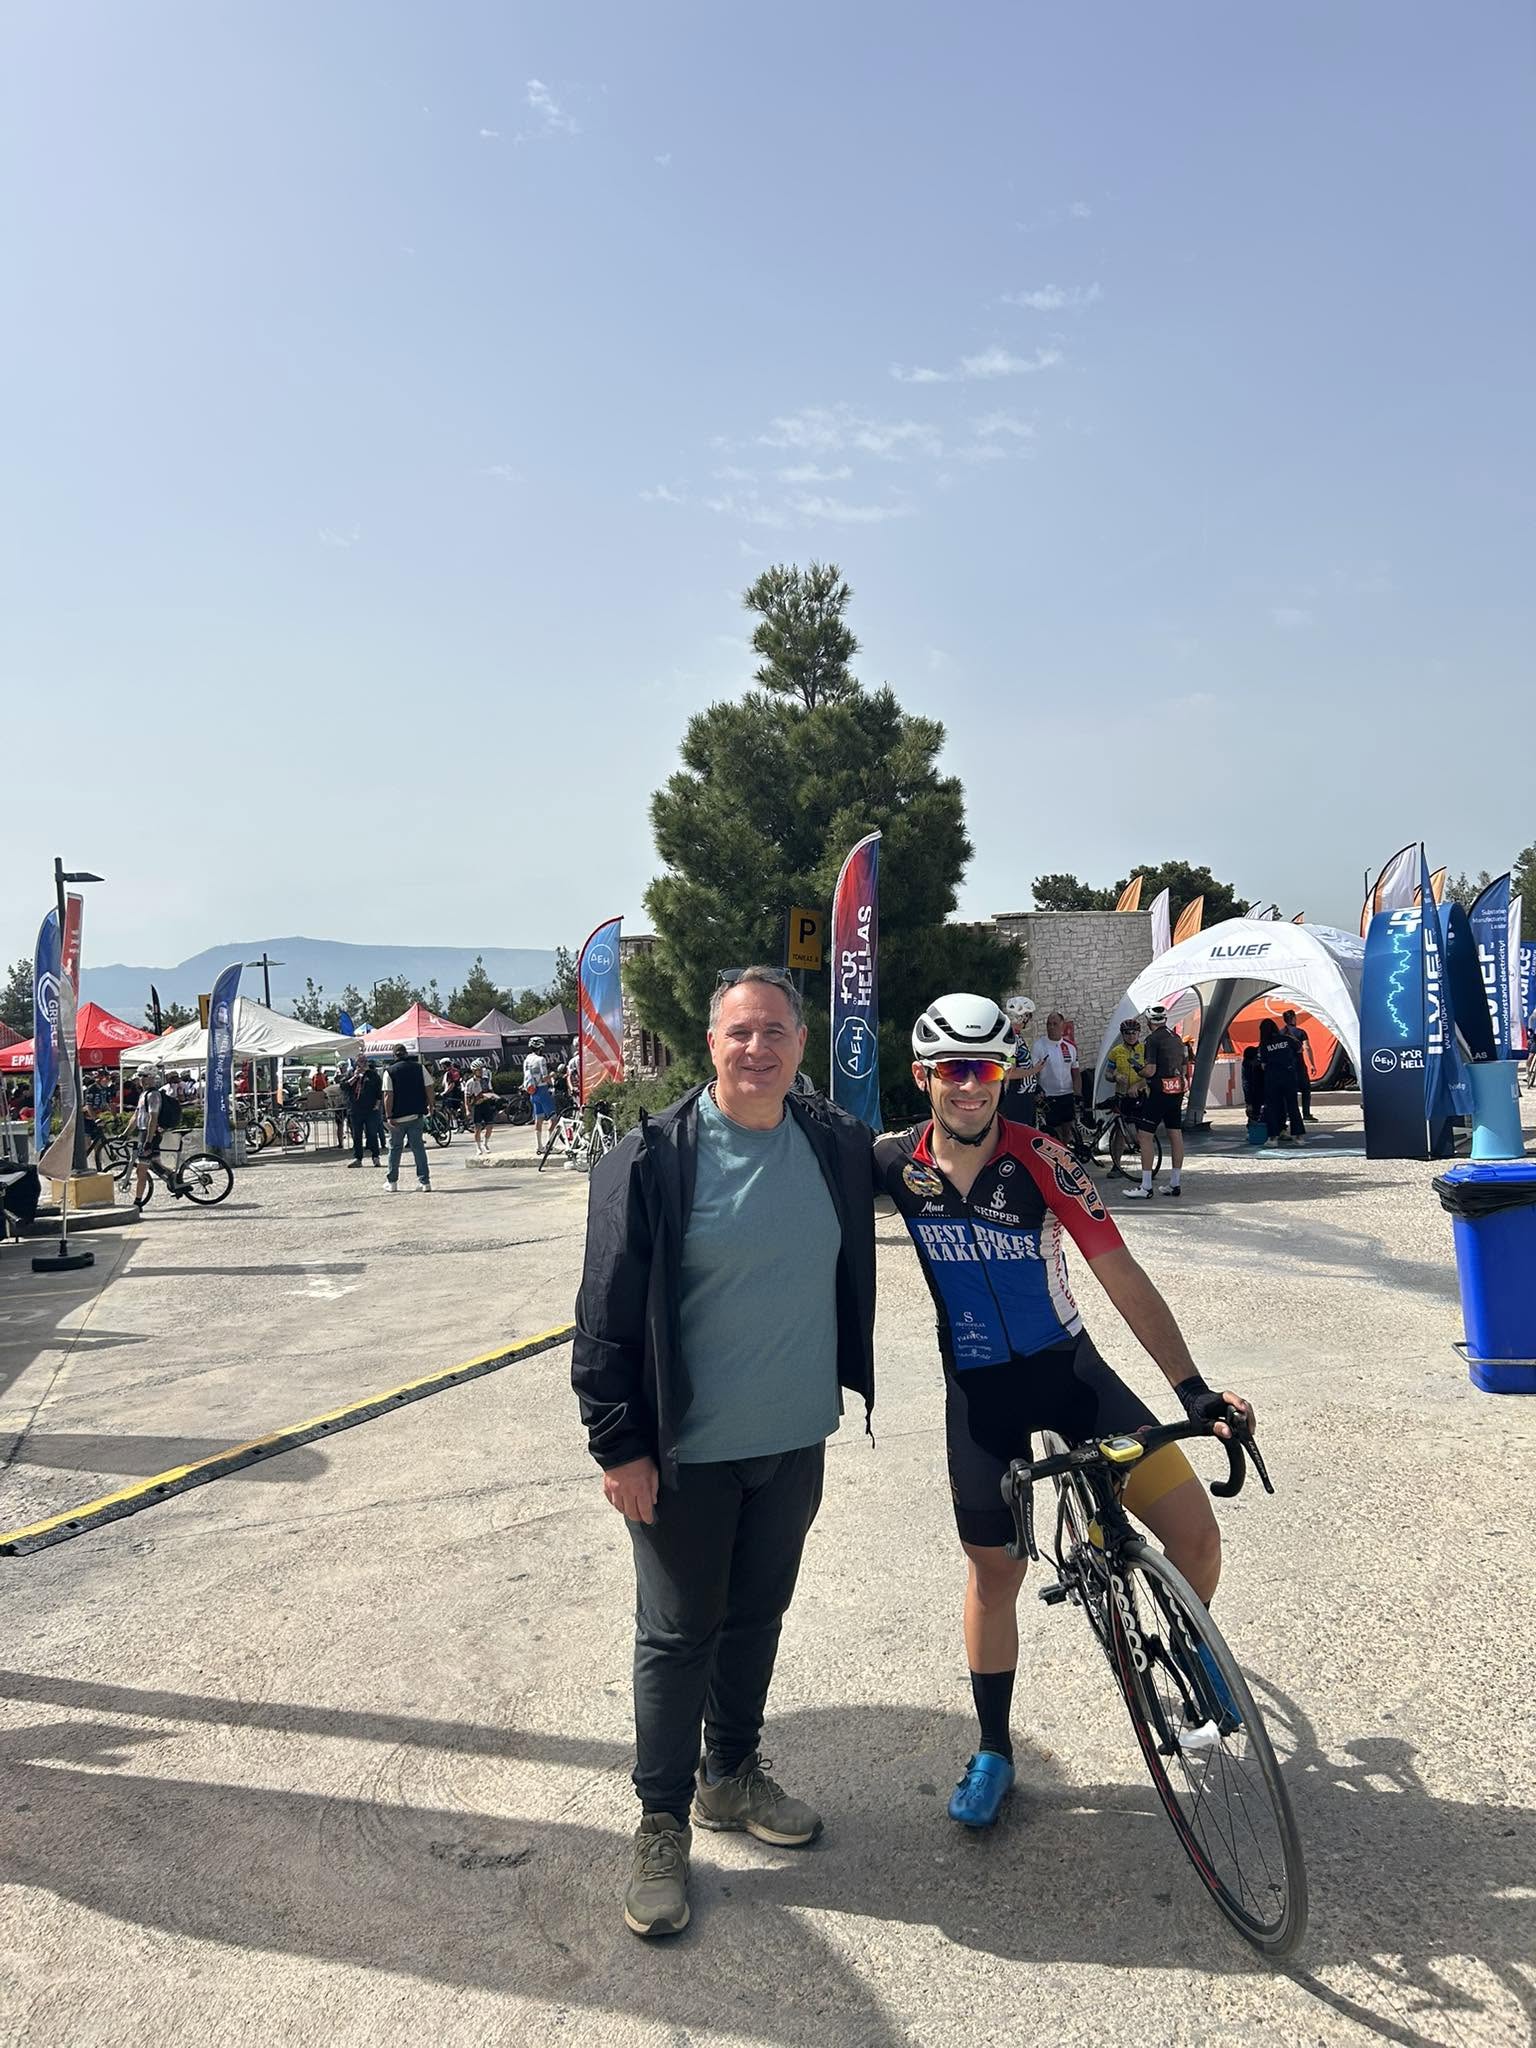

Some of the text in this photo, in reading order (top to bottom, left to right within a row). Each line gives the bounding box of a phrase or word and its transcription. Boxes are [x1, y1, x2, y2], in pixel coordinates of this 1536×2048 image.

[800, 918, 816, 944] P
[857, 905, 873, 1006] HELLAS
[1210, 943, 1272, 957] ILVIEF
[1424, 928, 1444, 1054] ILVIEF
[48, 999, 59, 1047] GREECE
[1267, 1041, 1288, 1052] ILVIEF
[1401, 1059, 1425, 1069] HELL
[974, 1204, 1020, 1223] SKIPPER
[917, 1224, 968, 1243] BEST
[971, 1223, 1036, 1252] BIKES
